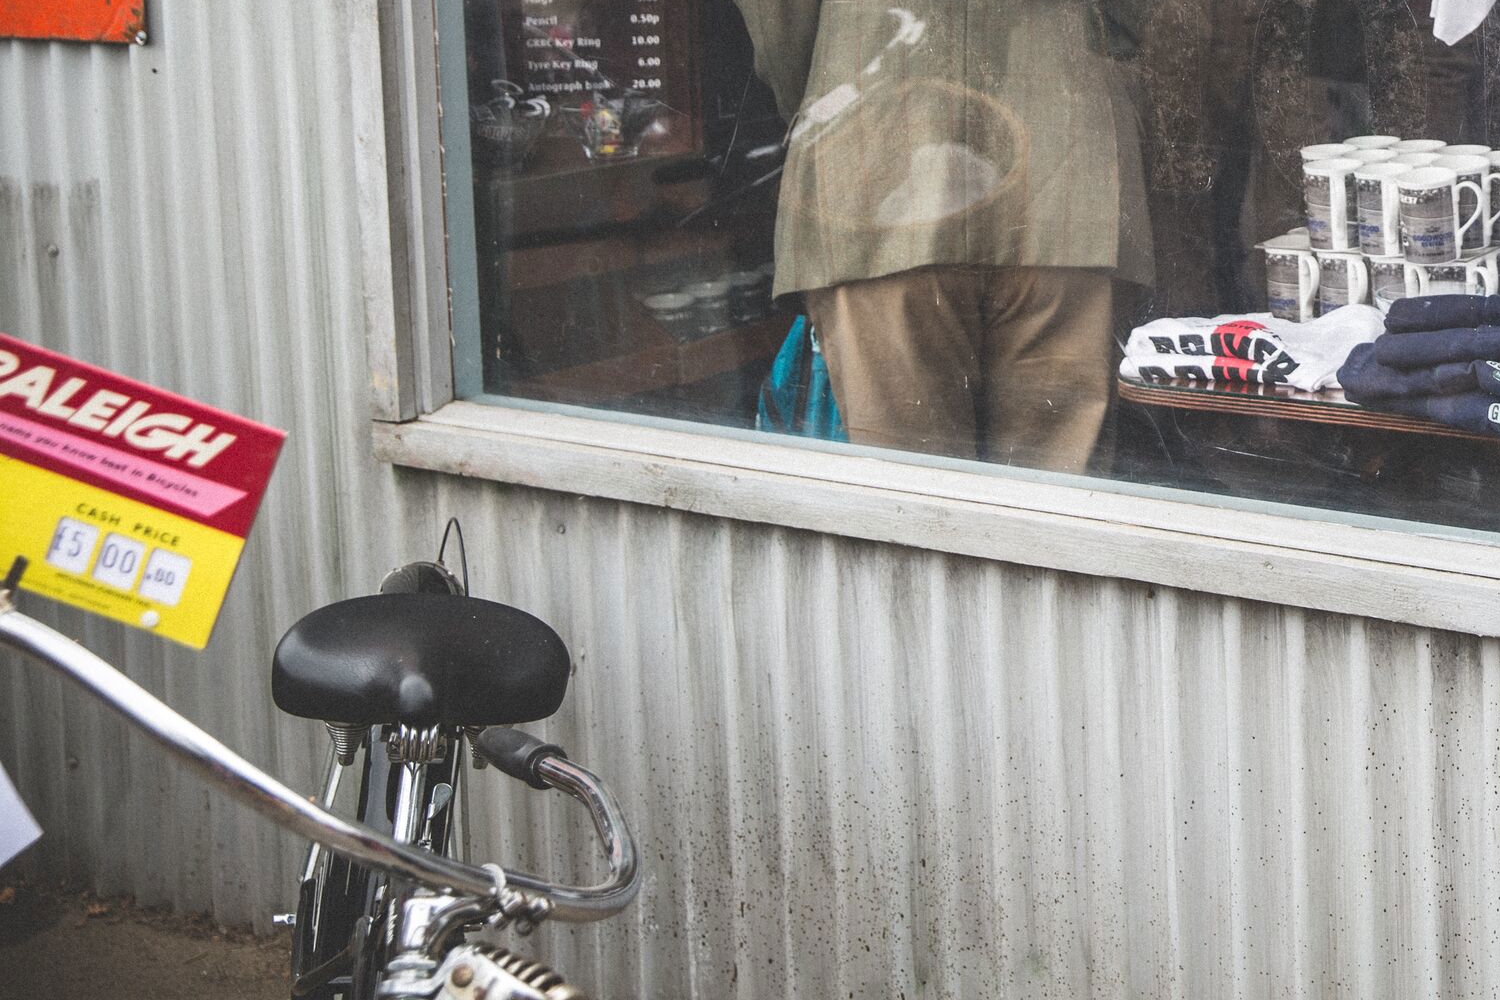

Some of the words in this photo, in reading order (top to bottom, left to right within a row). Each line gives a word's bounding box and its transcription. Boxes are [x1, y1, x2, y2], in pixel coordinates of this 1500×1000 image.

[525, 15, 558, 27] Pencil
[555, 37, 574, 49] Key
[576, 37, 601, 49] Ring
[528, 61, 551, 71] Tyre
[552, 60, 572, 71] Key
[574, 59, 599, 71] Ring
[528, 80, 582, 93] Autograph
[35, 437, 58, 448] you
[62, 444, 97, 460] know
[131, 468, 143, 477] in
[146, 473, 198, 497] Bicycles
[75, 503, 121, 526] CASH
[133, 523, 181, 546] PRICE
